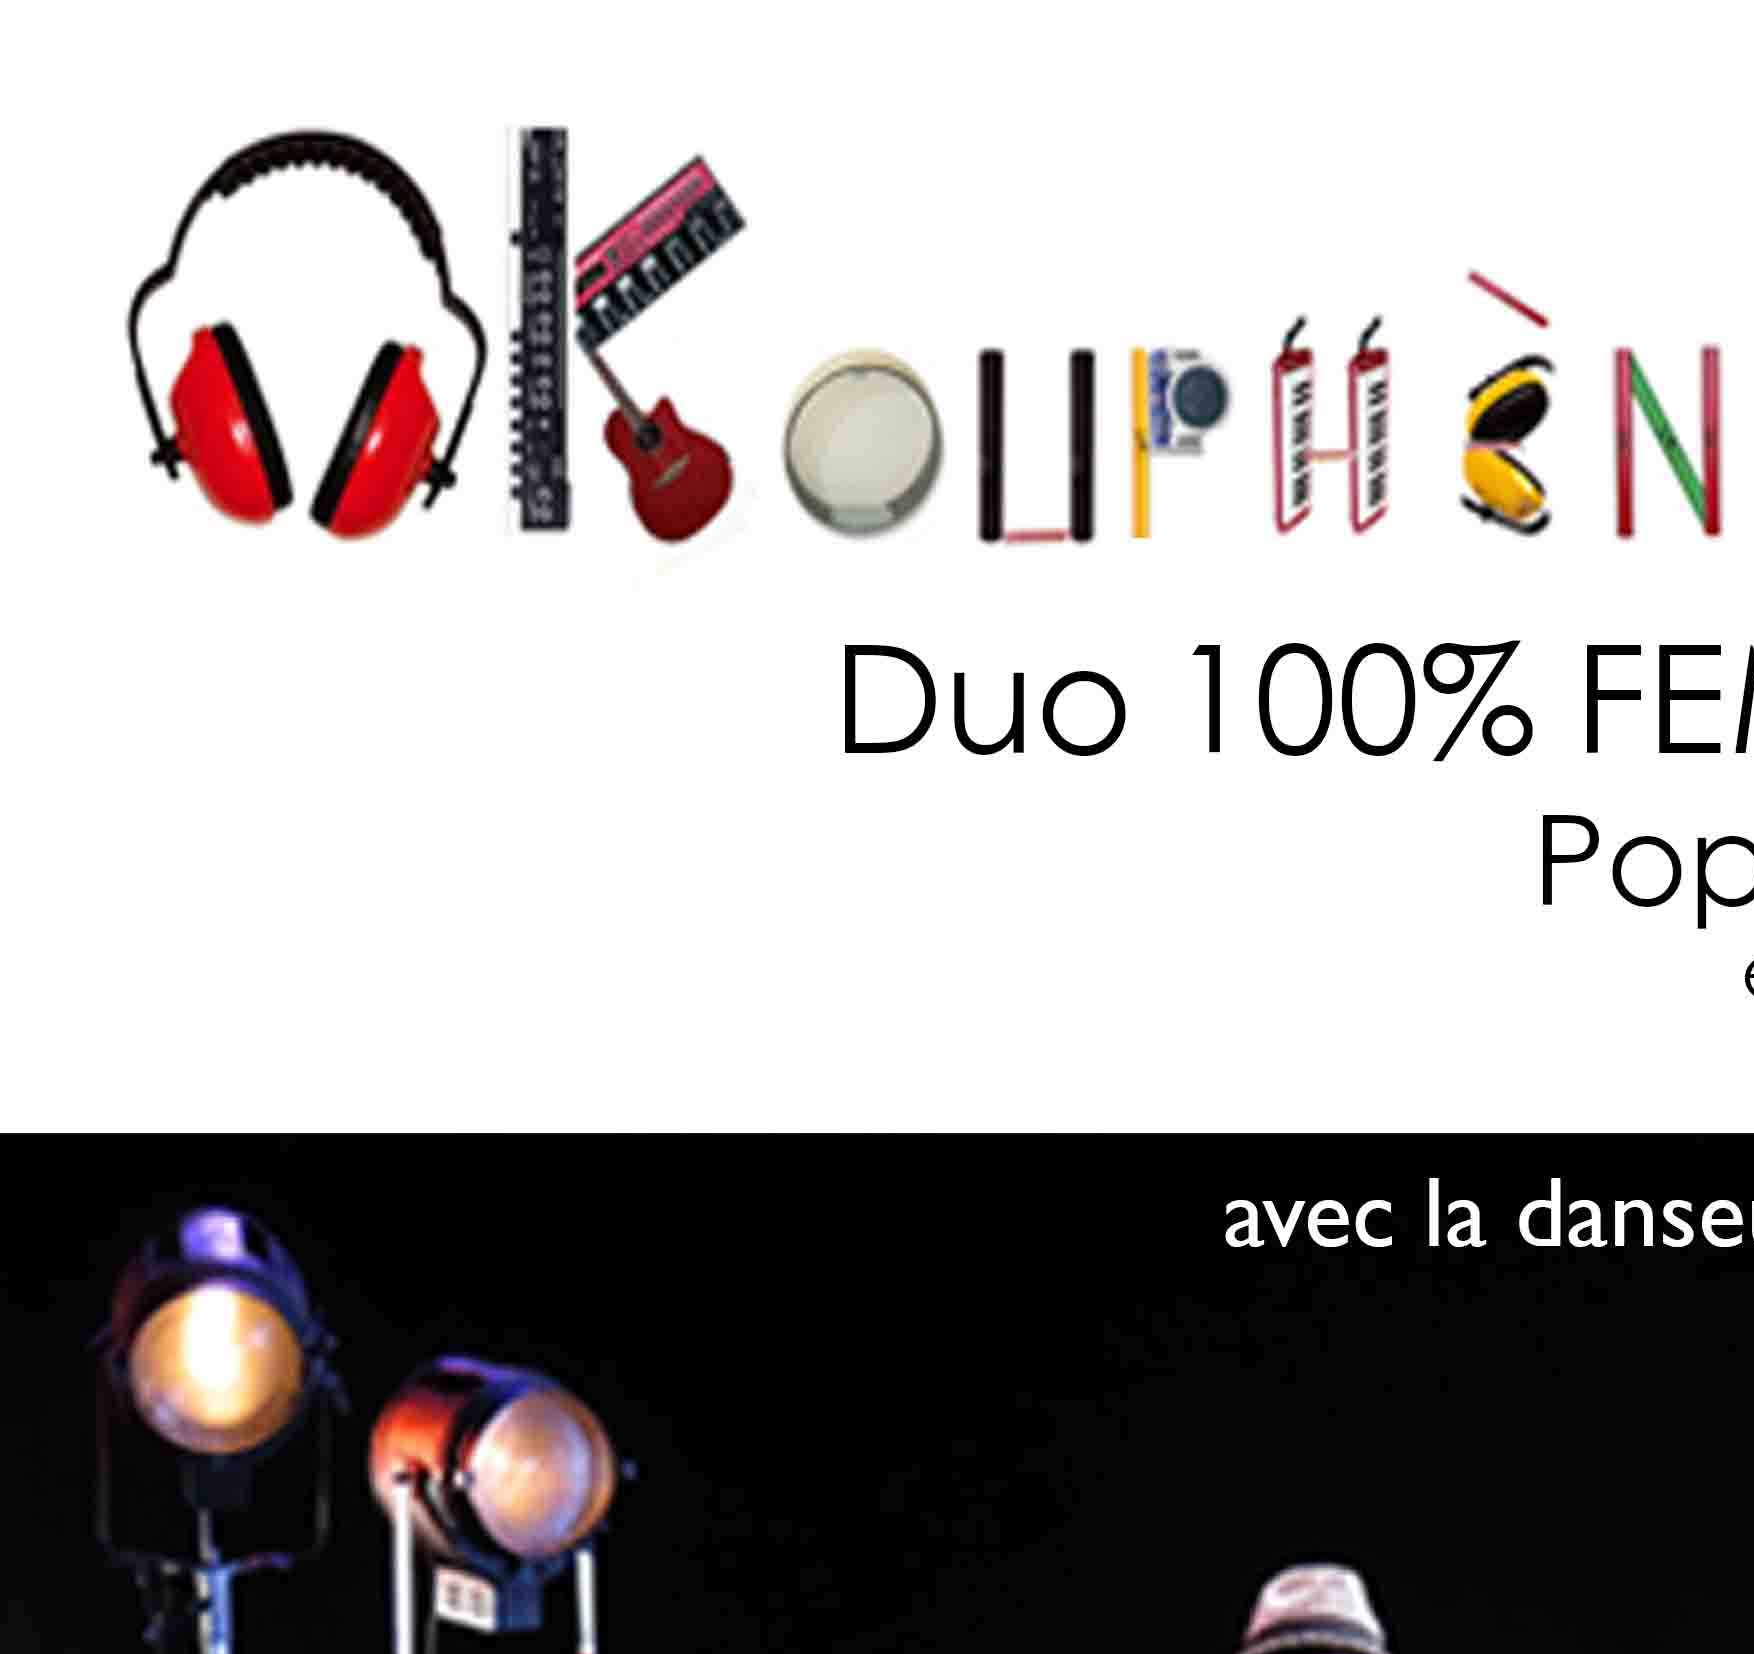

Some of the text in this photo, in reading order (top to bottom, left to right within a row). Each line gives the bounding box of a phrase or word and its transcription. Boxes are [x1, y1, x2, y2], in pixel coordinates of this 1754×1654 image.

[845, 645, 1125, 756] Duo
[1193, 641, 1532, 761] 100%
[1224, 1200, 1393, 1248] avec
[1428, 1177, 1487, 1248] la
